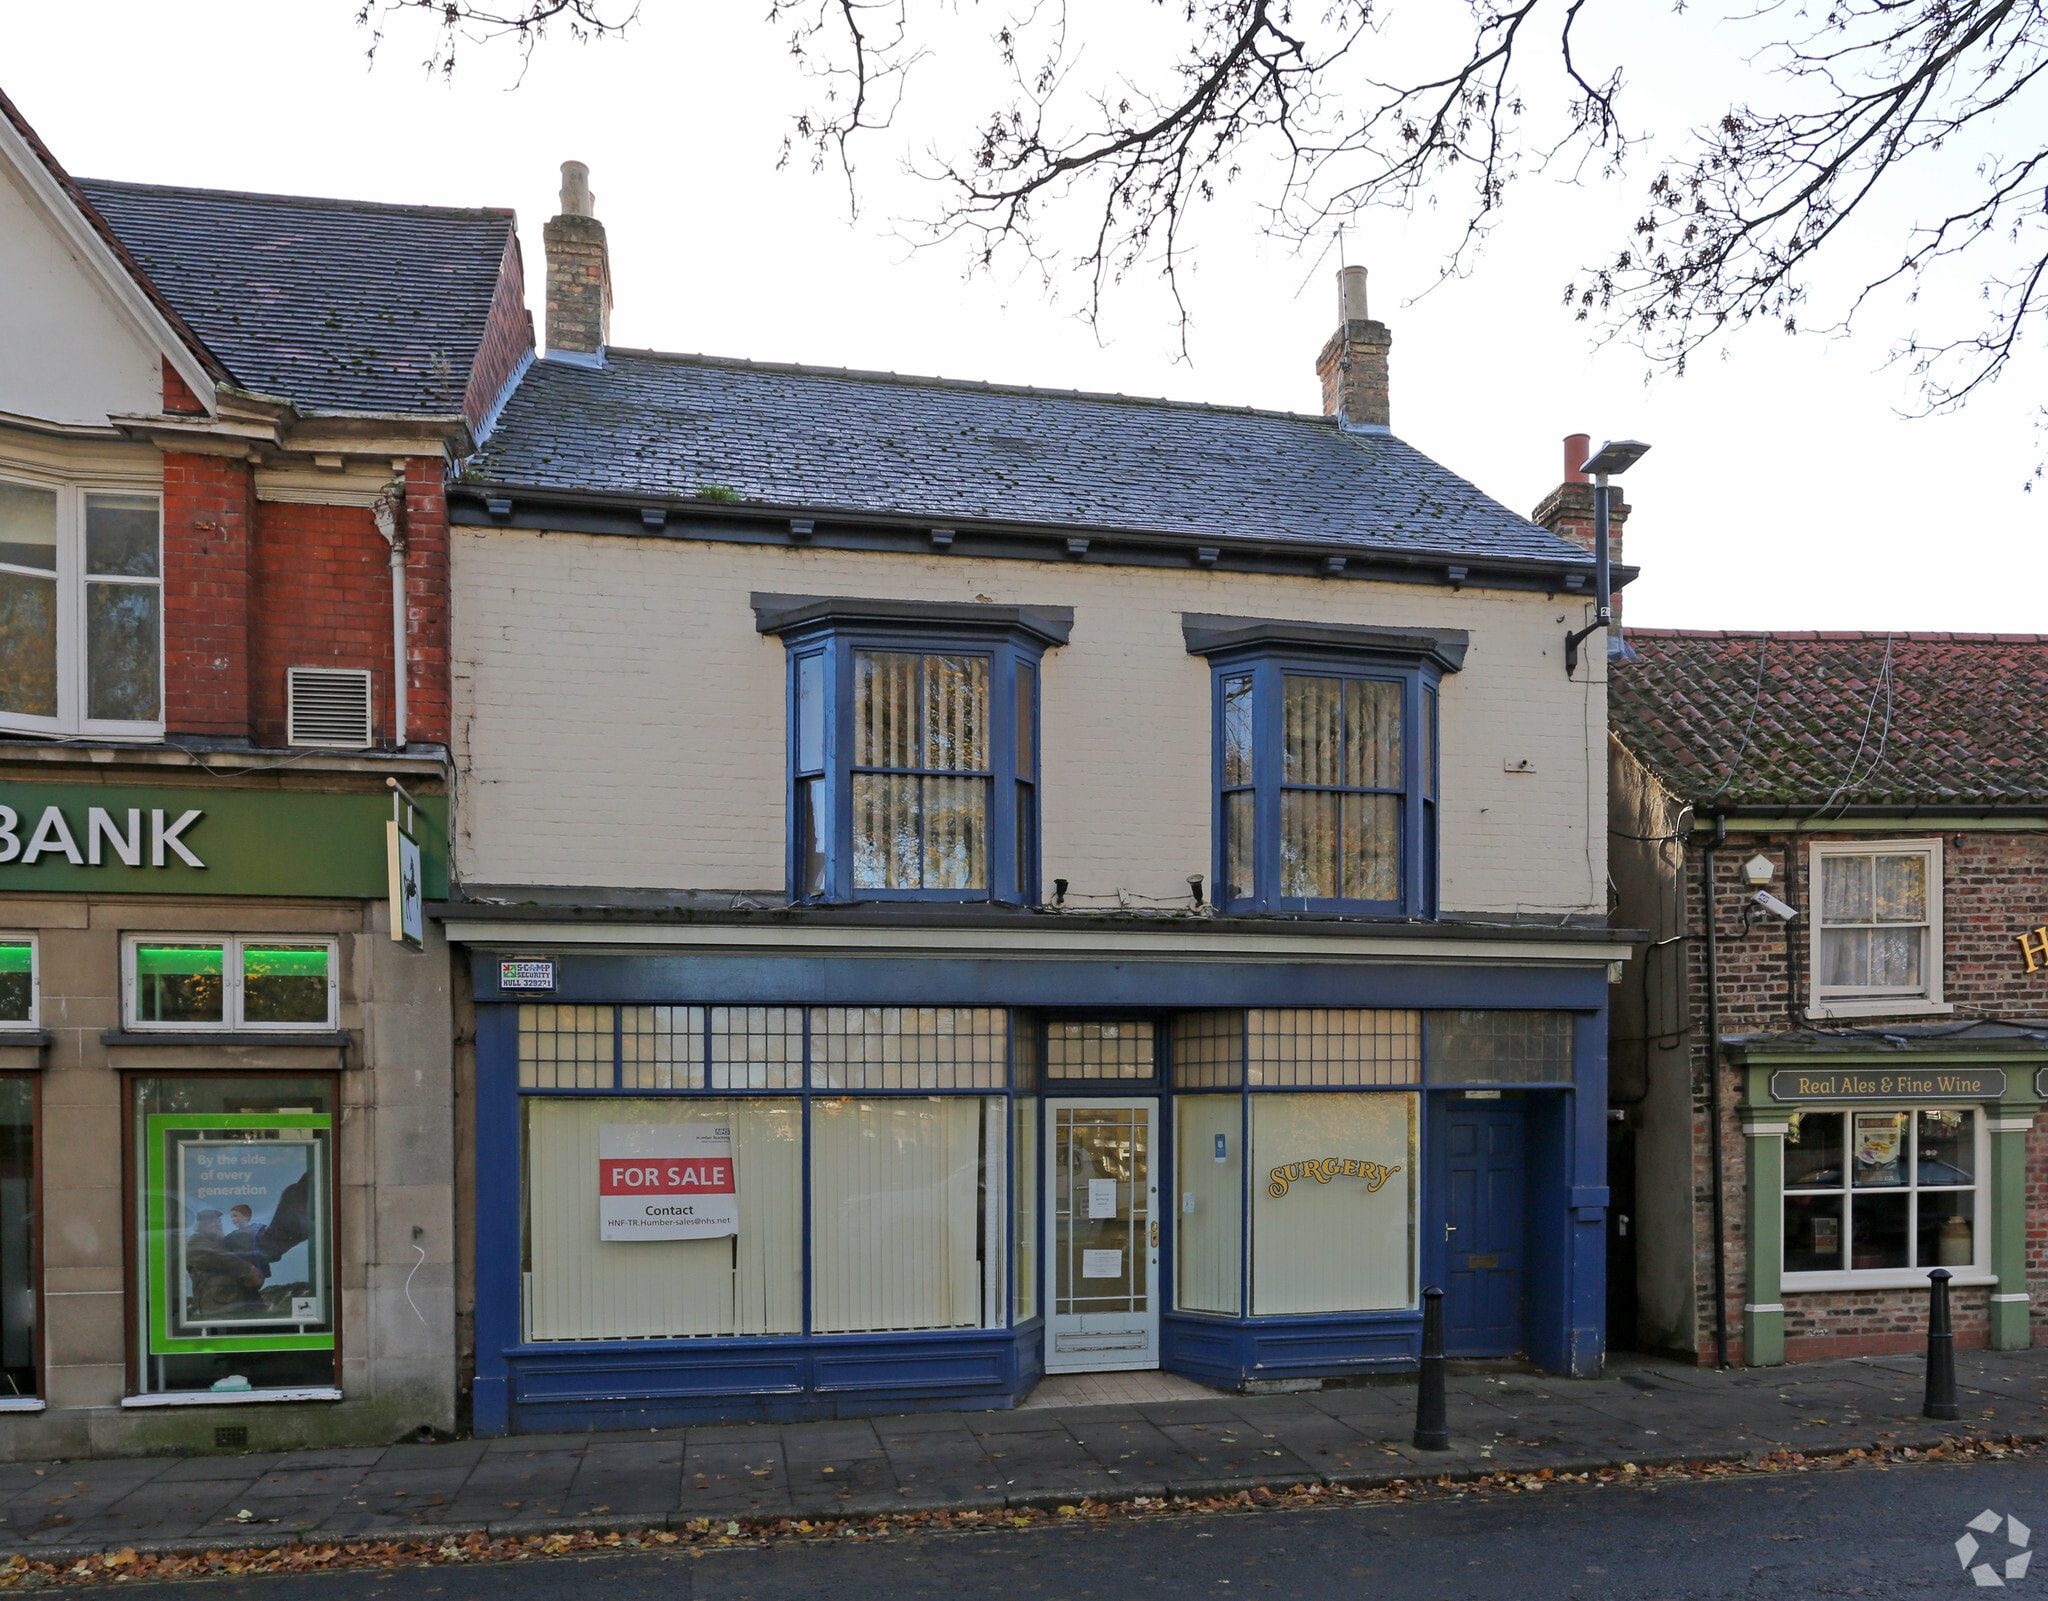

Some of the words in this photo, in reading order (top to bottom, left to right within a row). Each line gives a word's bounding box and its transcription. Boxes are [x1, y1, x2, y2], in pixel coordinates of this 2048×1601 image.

[0, 805, 206, 868] BANK
[1799, 1076, 1836, 1094] Real
[1841, 1076, 1876, 1093] Ales
[1881, 1076, 1893, 1093] &
[1897, 1076, 1933, 1093] Fine
[1937, 1075, 1981, 1092] Wine
[198, 1154, 214, 1168] By
[217, 1154, 238, 1165] the
[241, 1153, 267, 1165] side
[200, 1169, 215, 1180] of
[216, 1171, 252, 1182] every
[612, 1167, 660, 1187] FOR
[667, 1166, 725, 1186] SALE
[1269, 1157, 1401, 1198] SURGERY
[198, 1184, 267, 1198] generation
[645, 1206, 694, 1216] Contact
[608, 1217, 731, 1227] HNF-TR.Humber-sales@nhs.net
